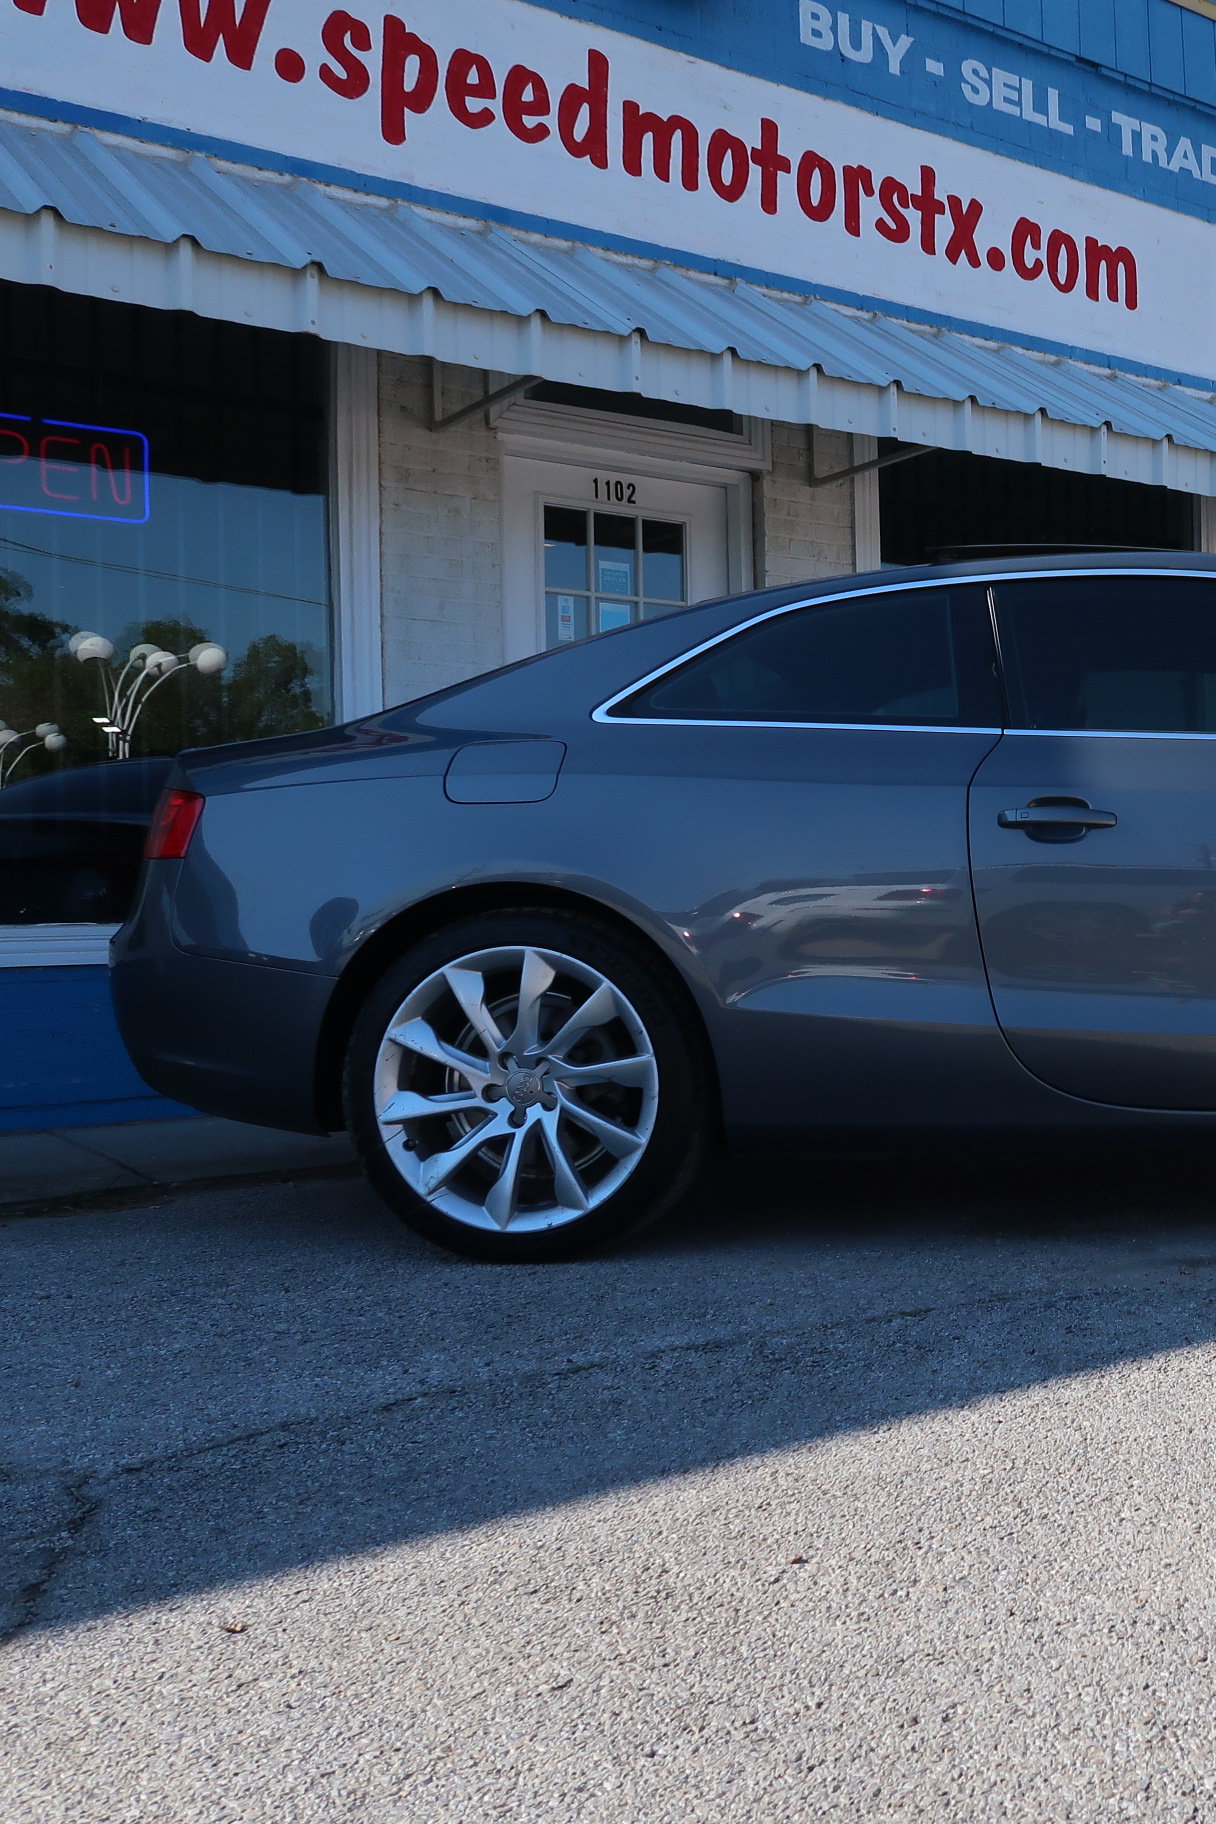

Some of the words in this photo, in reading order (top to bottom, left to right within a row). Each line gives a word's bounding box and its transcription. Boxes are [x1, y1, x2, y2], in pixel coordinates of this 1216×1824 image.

[799, 0, 915, 77] BUY
[961, 60, 1074, 135] SELL
[13, 0, 1138, 310] w.speedmotorstx.com
[592, 477, 637, 505] 1102
